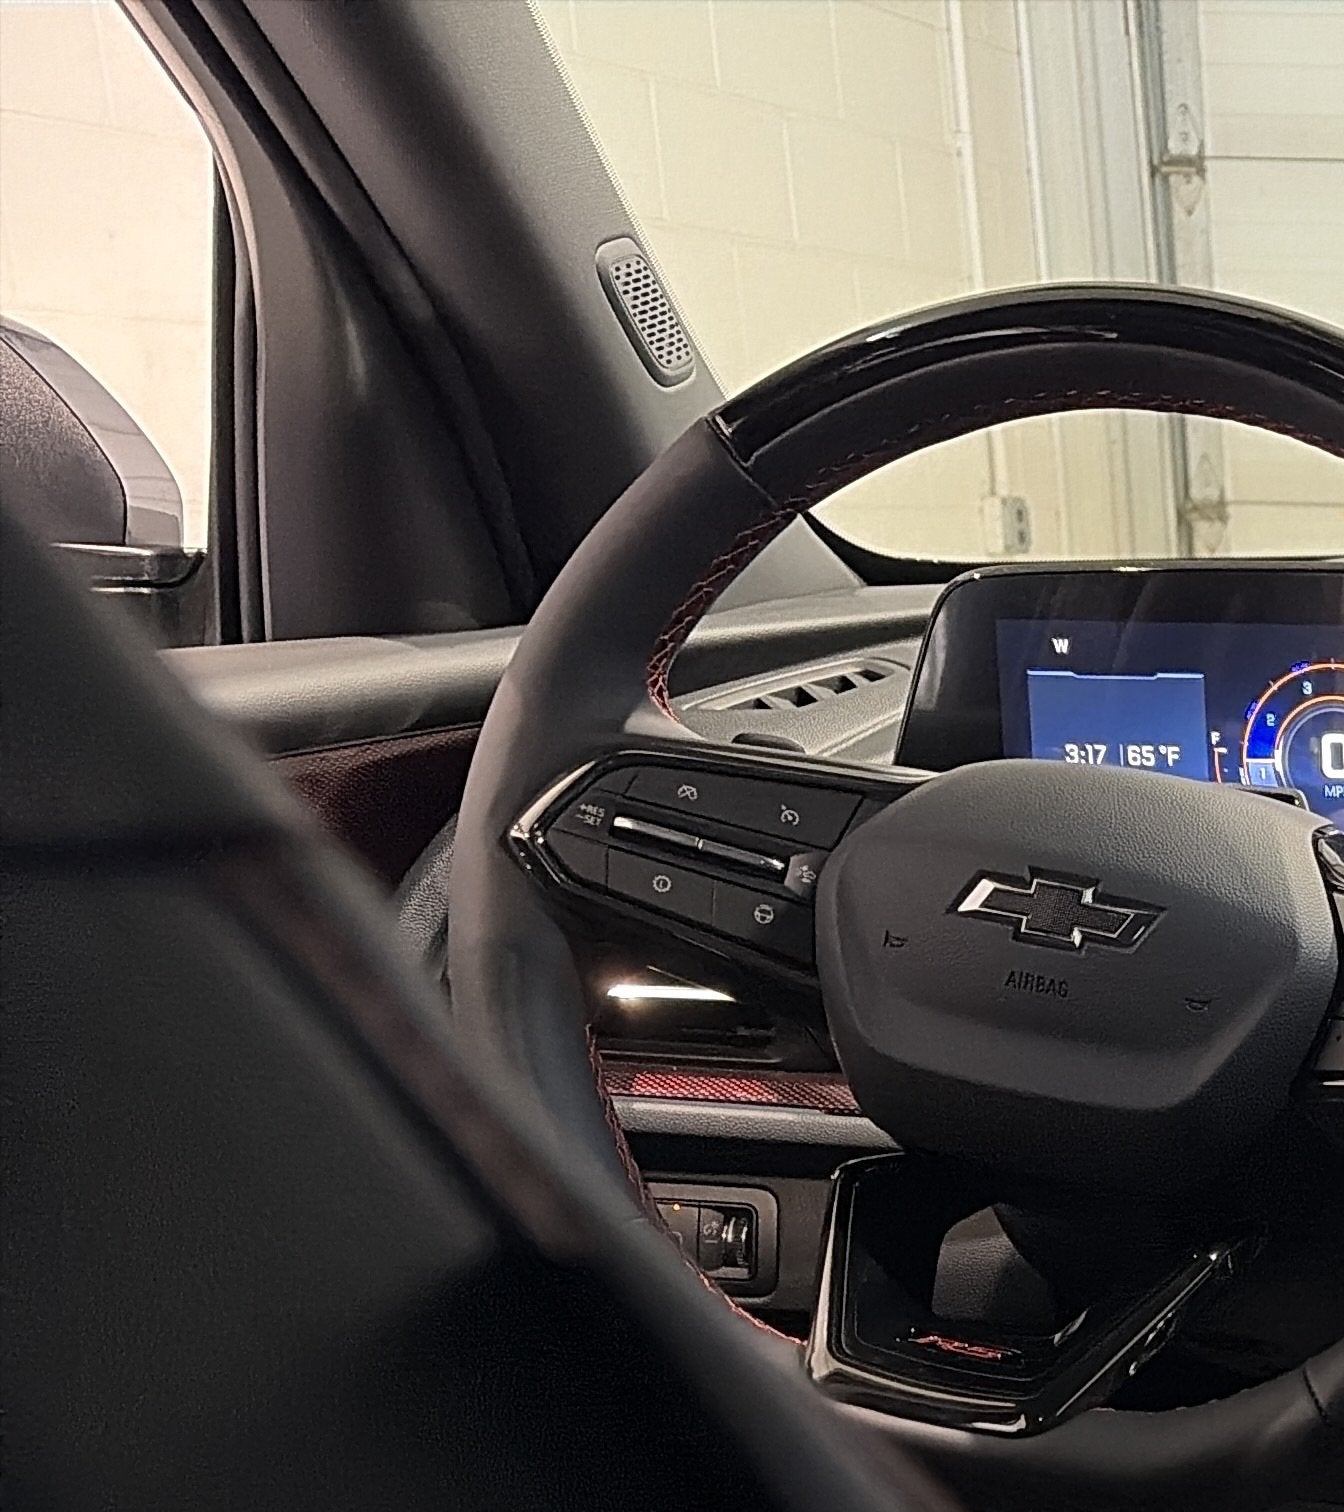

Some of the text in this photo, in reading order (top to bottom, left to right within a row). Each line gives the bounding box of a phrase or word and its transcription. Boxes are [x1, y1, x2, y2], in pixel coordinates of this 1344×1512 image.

[1052, 637, 1069, 654] W
[1302, 681, 1313, 695] 3
[1266, 713, 1276, 727] 2
[1064, 743, 1107, 765] 3:17
[1004, 970, 1069, 998] AIRBAG
